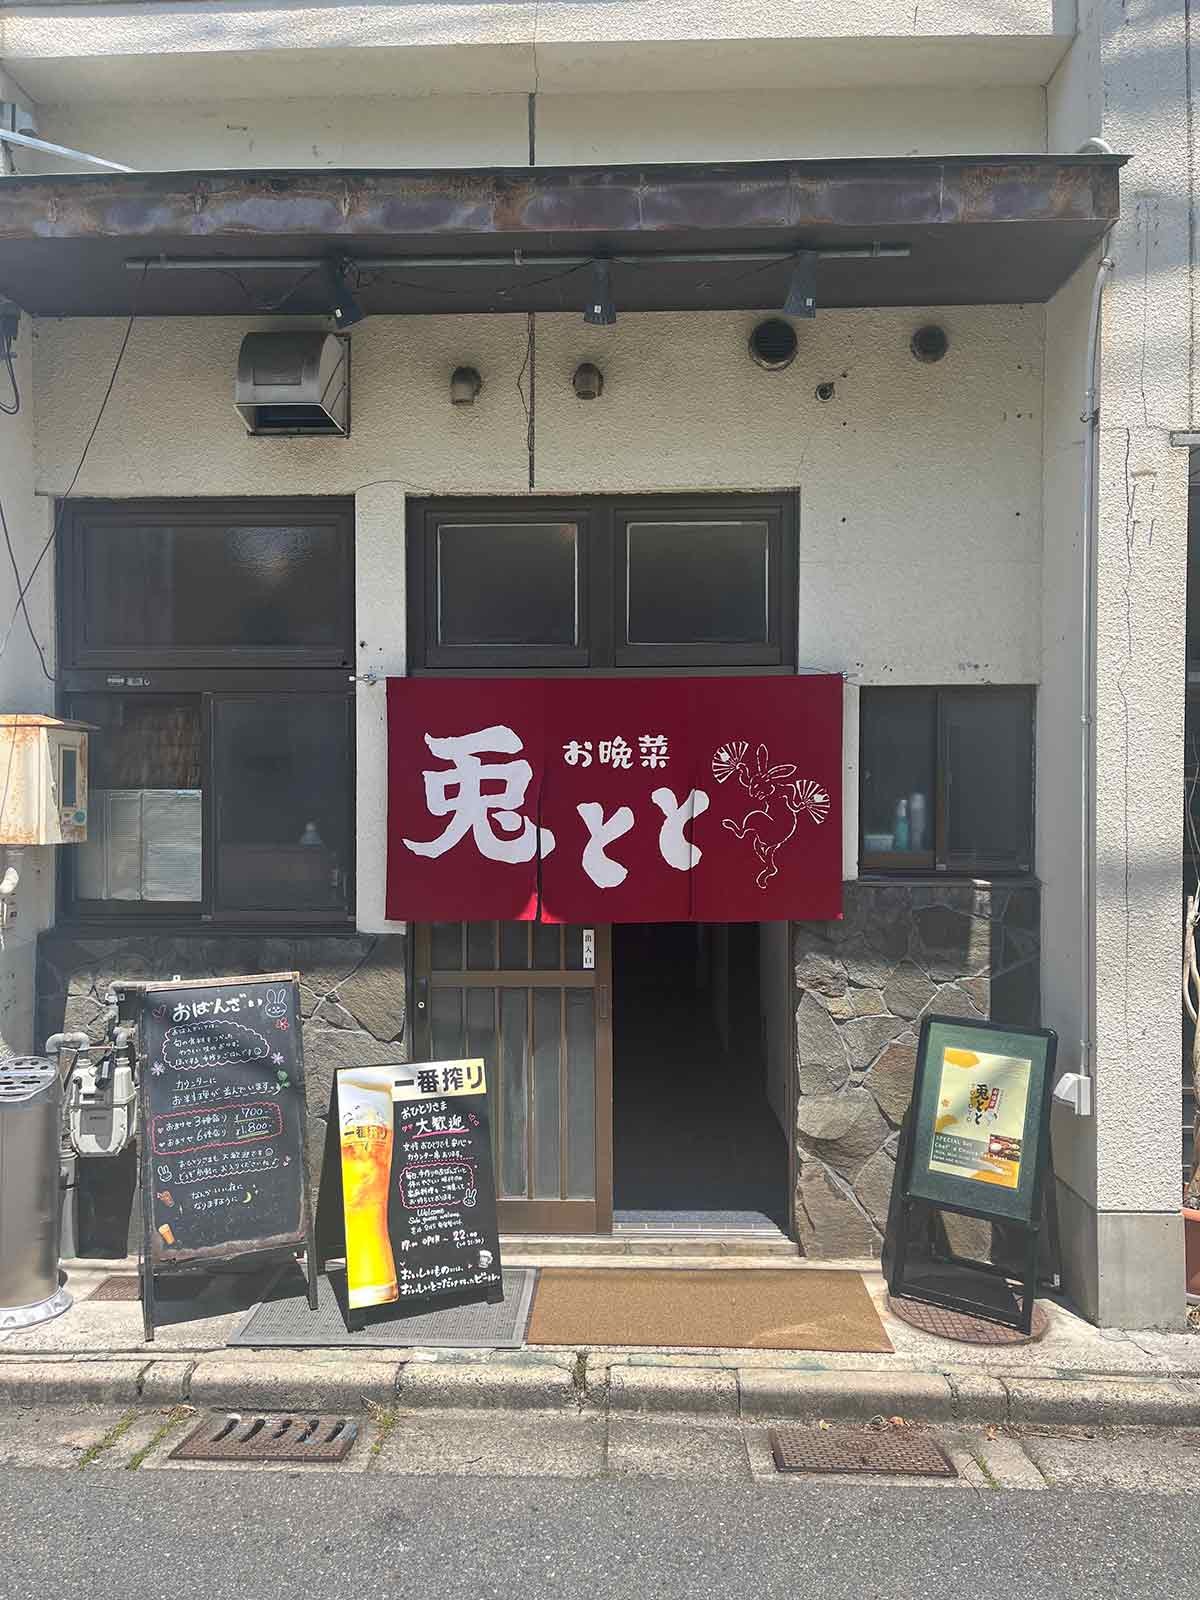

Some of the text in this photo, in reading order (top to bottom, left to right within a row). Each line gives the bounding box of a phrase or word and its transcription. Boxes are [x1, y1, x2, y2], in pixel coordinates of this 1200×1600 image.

[563, 735, 670, 769] お晩菜
[402, 725, 710, 889] 兎とと
[172, 993, 263, 1022] おばんざい
[395, 1066, 483, 1094] 一番搾り
[400, 1101, 447, 1120] おひとりさま
[415, 1114, 465, 1136] 大歓迎
